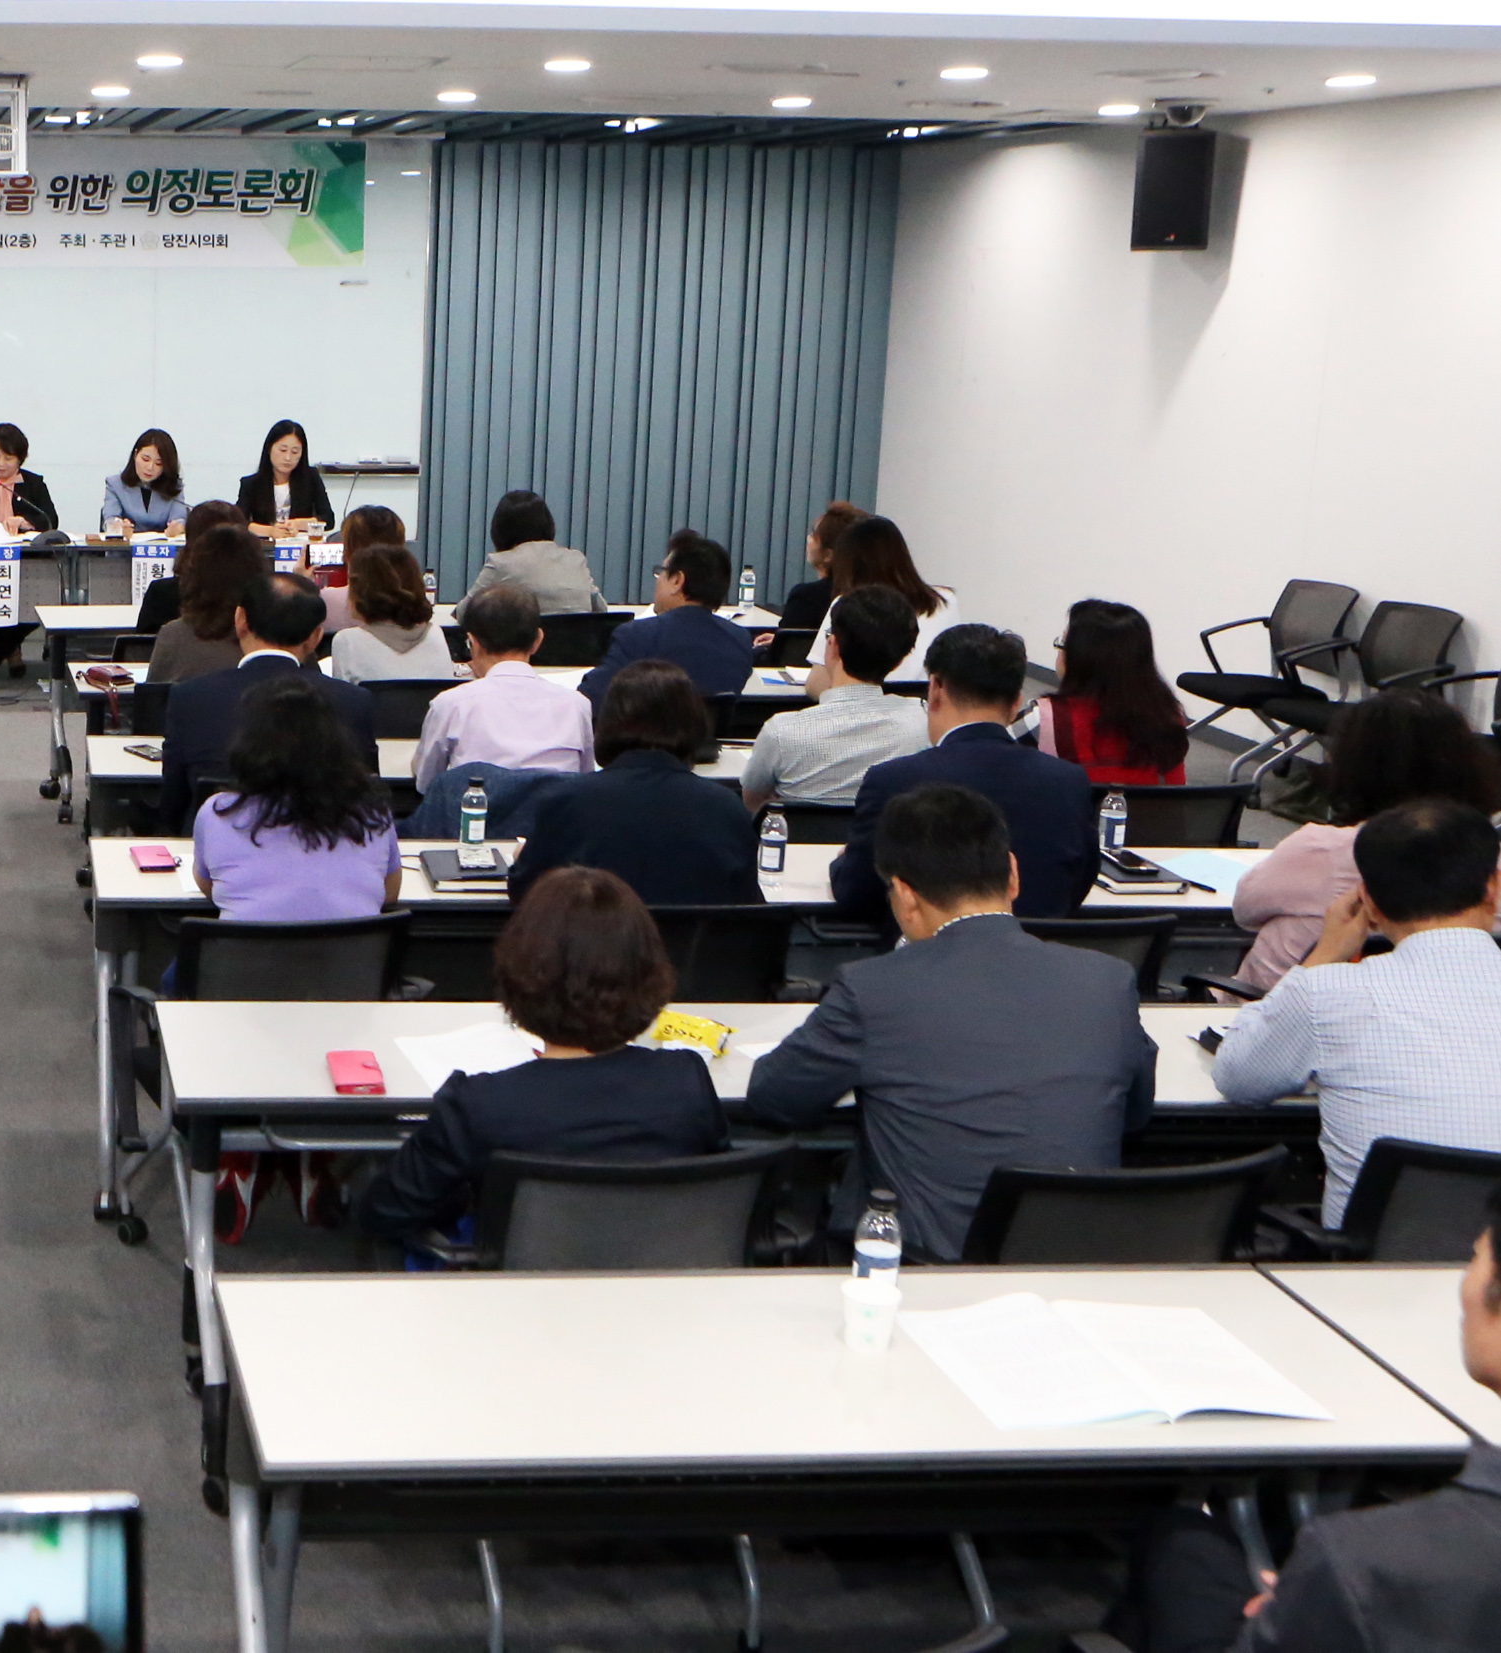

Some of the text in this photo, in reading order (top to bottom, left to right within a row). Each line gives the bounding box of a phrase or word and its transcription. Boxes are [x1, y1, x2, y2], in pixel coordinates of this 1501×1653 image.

[47, 174, 113, 213] 위한
[121, 167, 316, 215] 의정토론회
[59, 233, 127, 248] 주최 주관
[162, 233, 228, 248] 당진시의회
[135, 546, 170, 557] 토론자
[279, 549, 301, 560] 토론
